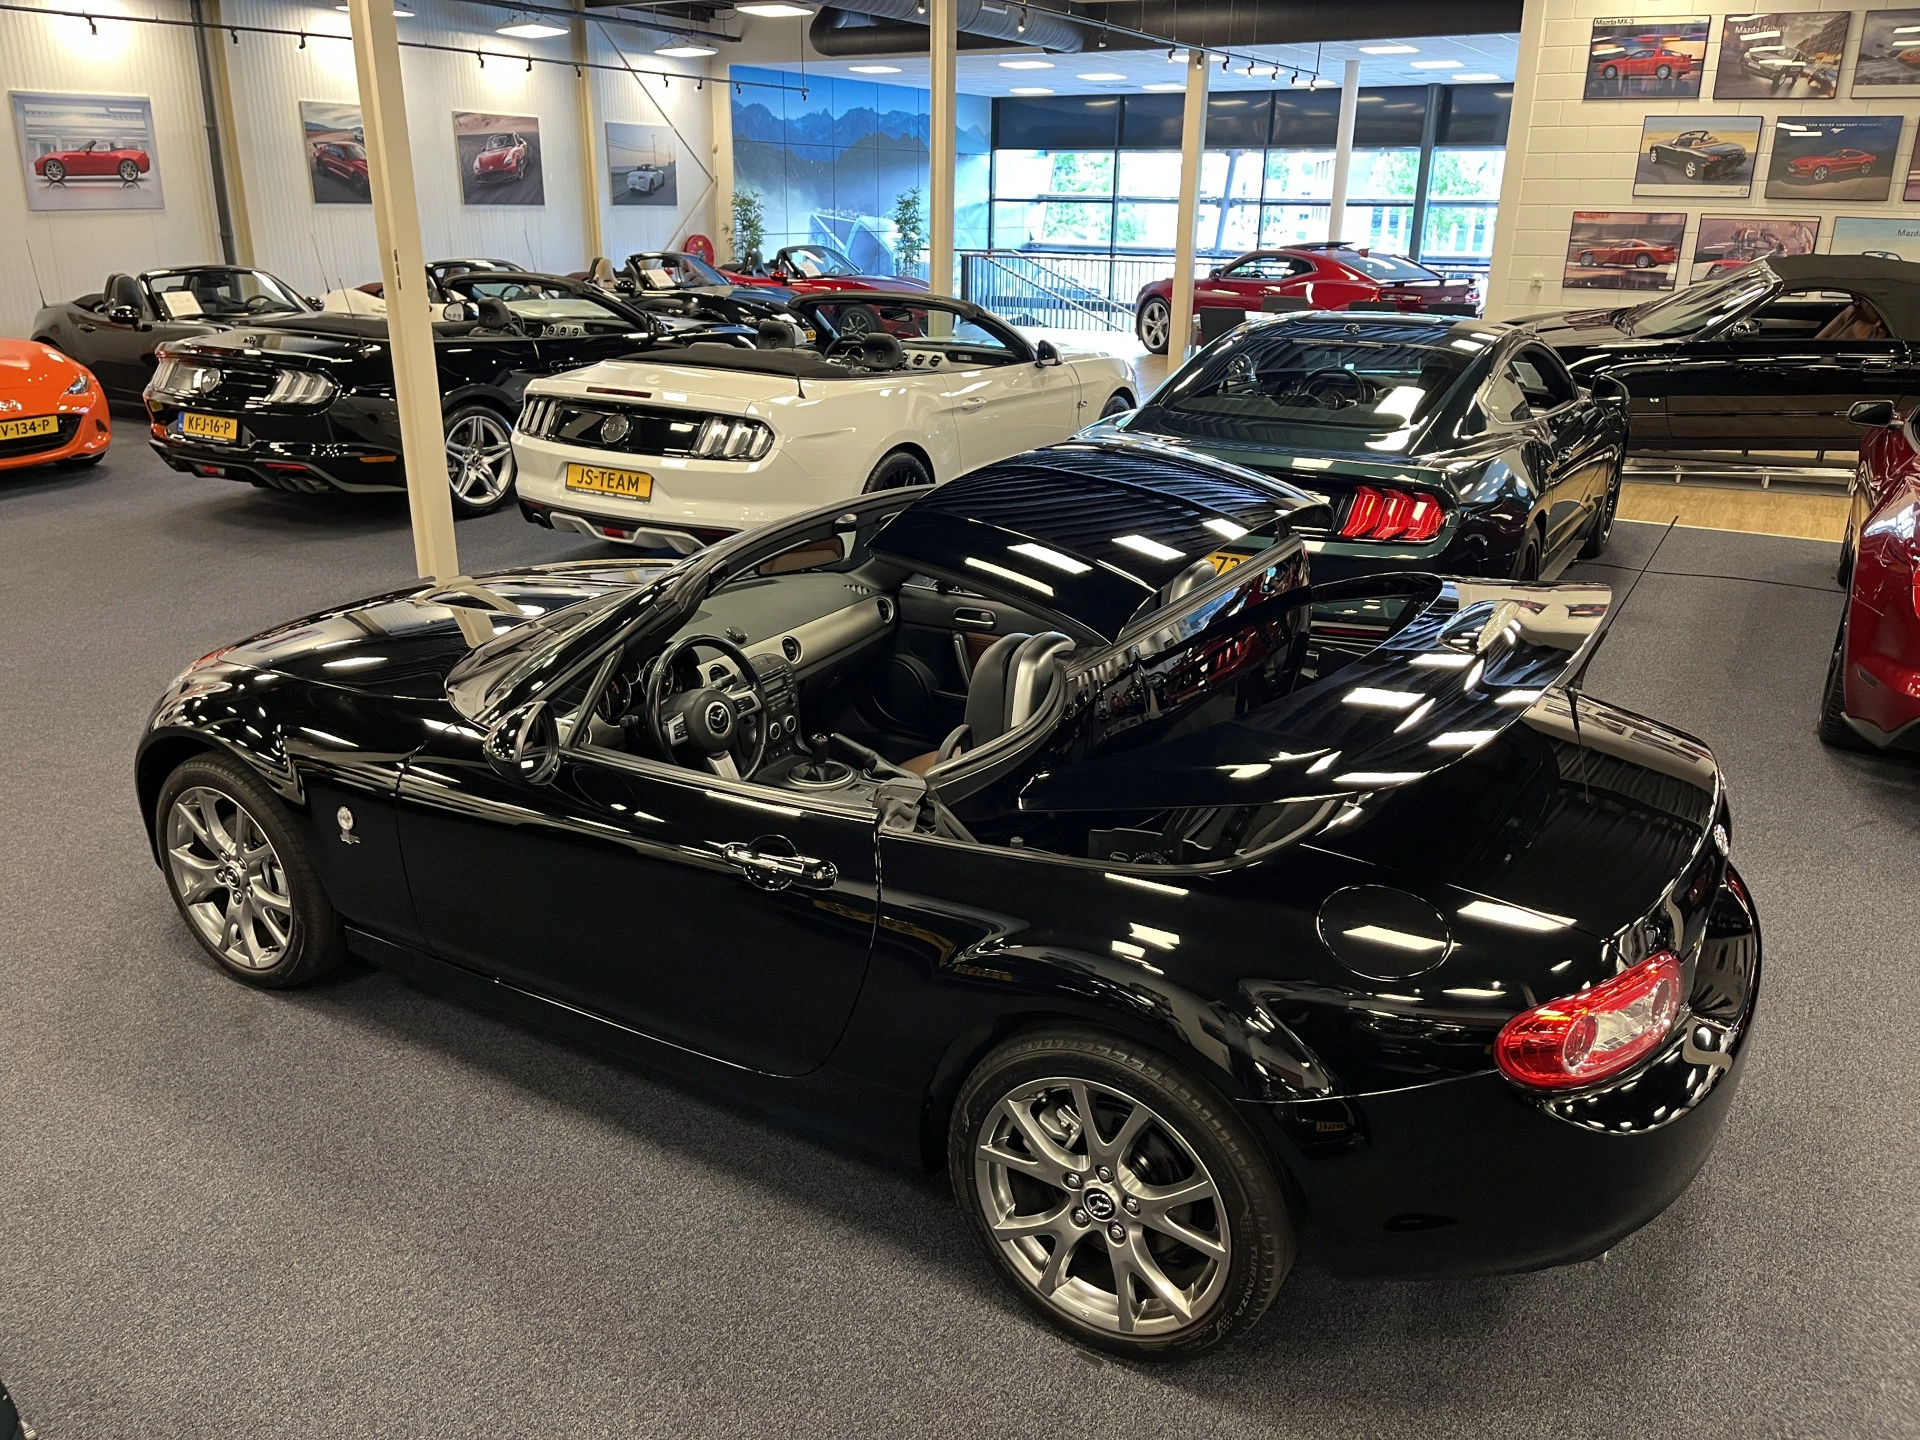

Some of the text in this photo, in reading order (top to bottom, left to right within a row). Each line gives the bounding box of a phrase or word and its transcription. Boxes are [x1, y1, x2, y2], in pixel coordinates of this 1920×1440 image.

[1734, 24, 1790, 34] Mazda Tribute
[1897, 229, 1920, 237] Mazd
[188, 416, 231, 434] KFJ-16-P
[576, 468, 641, 492] JS-TEAM
[1234, 1243, 1258, 1317] TURANZA
